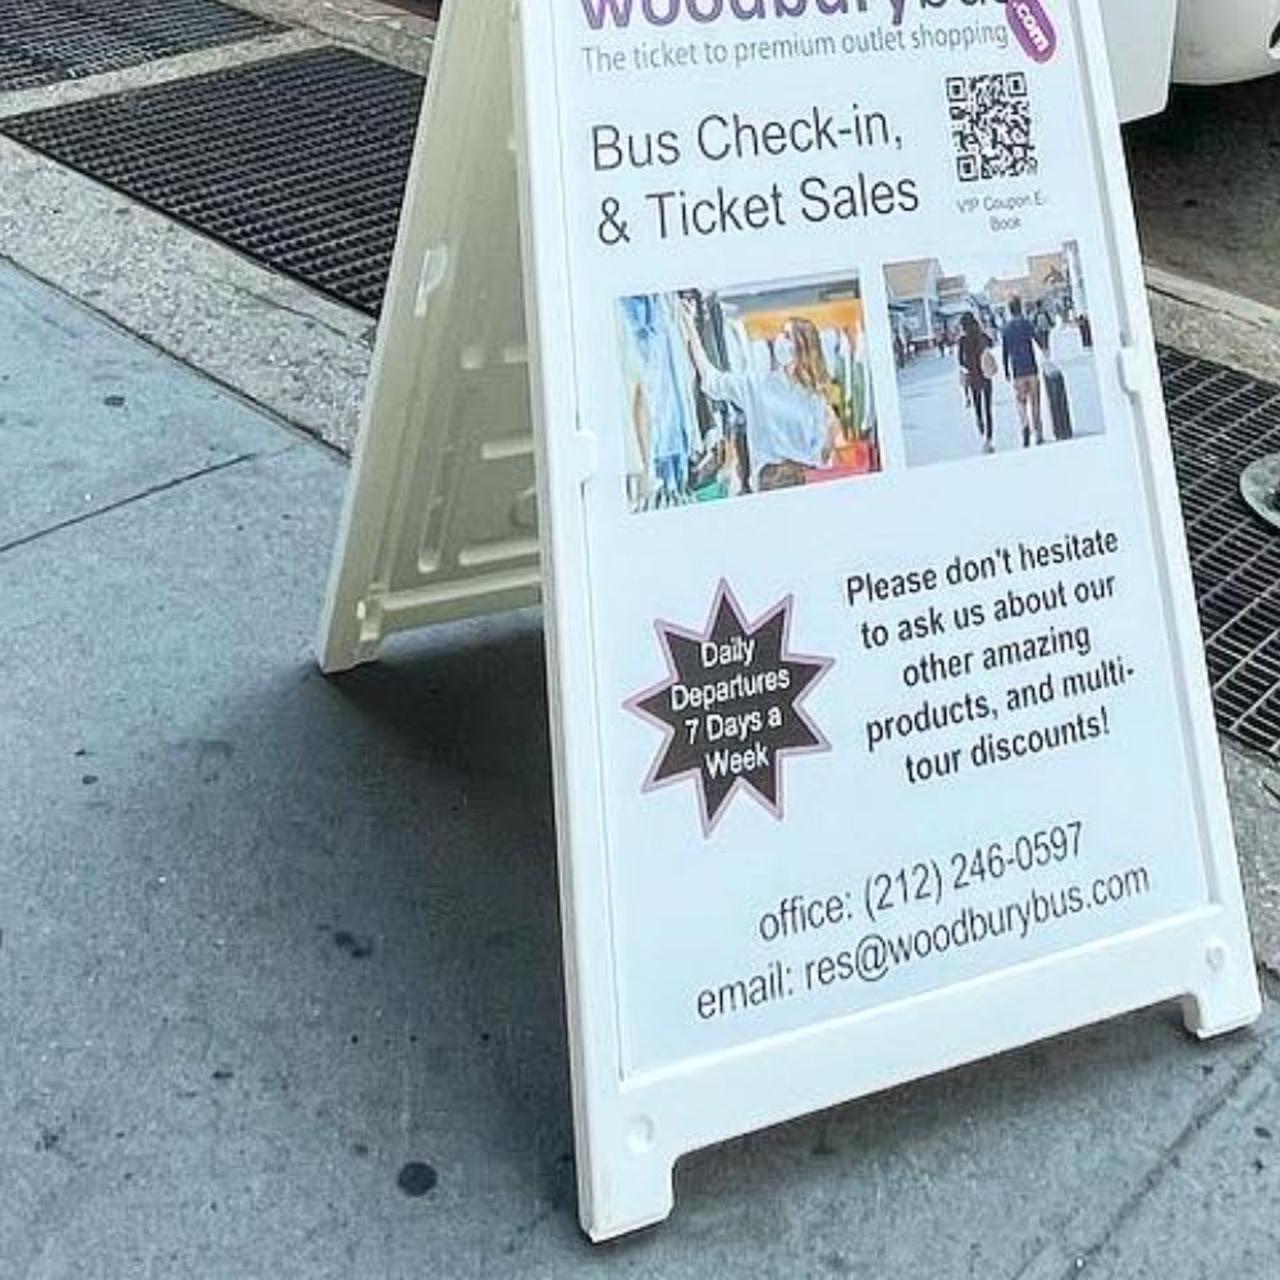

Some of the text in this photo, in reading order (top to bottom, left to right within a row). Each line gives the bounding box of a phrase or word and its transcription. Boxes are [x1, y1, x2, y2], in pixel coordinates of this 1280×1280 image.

[581, 19, 1010, 75] The ticket to premium outlet shopping
[592, 103, 904, 171] Bus Check-in,
[597, 172, 921, 246] & Ticket Sales
[845, 528, 1119, 607] Please don't hesitate
[861, 573, 1117, 650] to ask us about our
[670, 665, 791, 713] Departures
[700, 637, 756, 670] Daily
[902, 623, 1093, 689] other amazing
[685, 707, 782, 744] 7 Days a
[865, 662, 1136, 752] products, and multi-
[705, 745, 770, 781] Week
[905, 705, 1111, 784] tour discounts!
[758, 820, 1084, 943] office: (212) 246-0597
[696, 863, 1151, 1020] email: res@woodburybus.com
